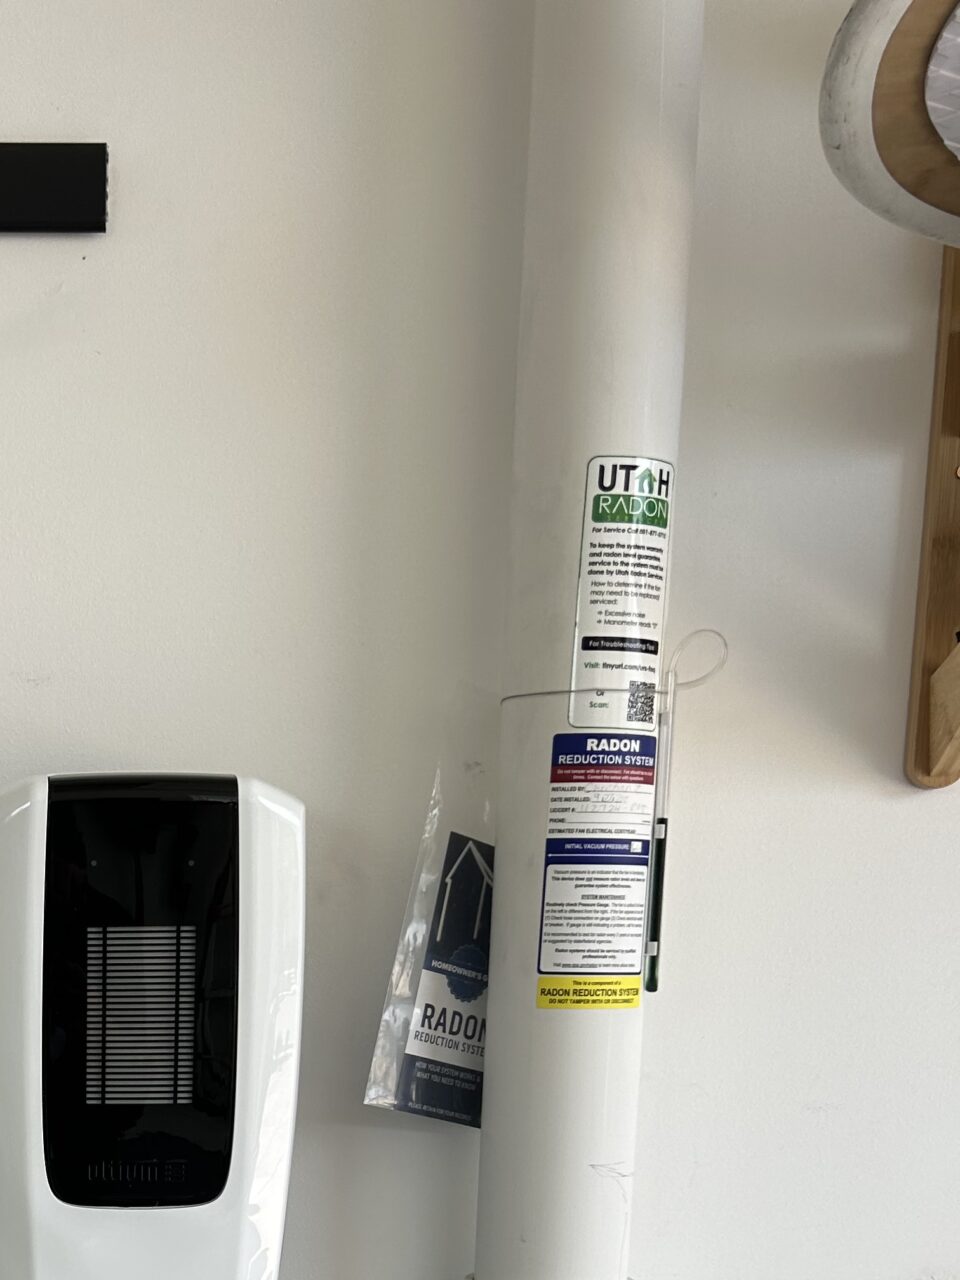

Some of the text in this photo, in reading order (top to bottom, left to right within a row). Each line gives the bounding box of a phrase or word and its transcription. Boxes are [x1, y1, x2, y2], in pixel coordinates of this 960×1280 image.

[598, 464, 670, 498] UTAH
[599, 495, 667, 519] RADON
[598, 542, 614, 550] keep
[586, 738, 640, 752] RADON
[558, 754, 654, 767] REDUCTION SYSTEM
[431, 959, 482, 980] HOMEOWNER'S
[541, 988, 570, 997] RADON
[573, 988, 617, 997] REDUCTION
[414, 1030, 485, 1057] REDUCTION SYSTE
